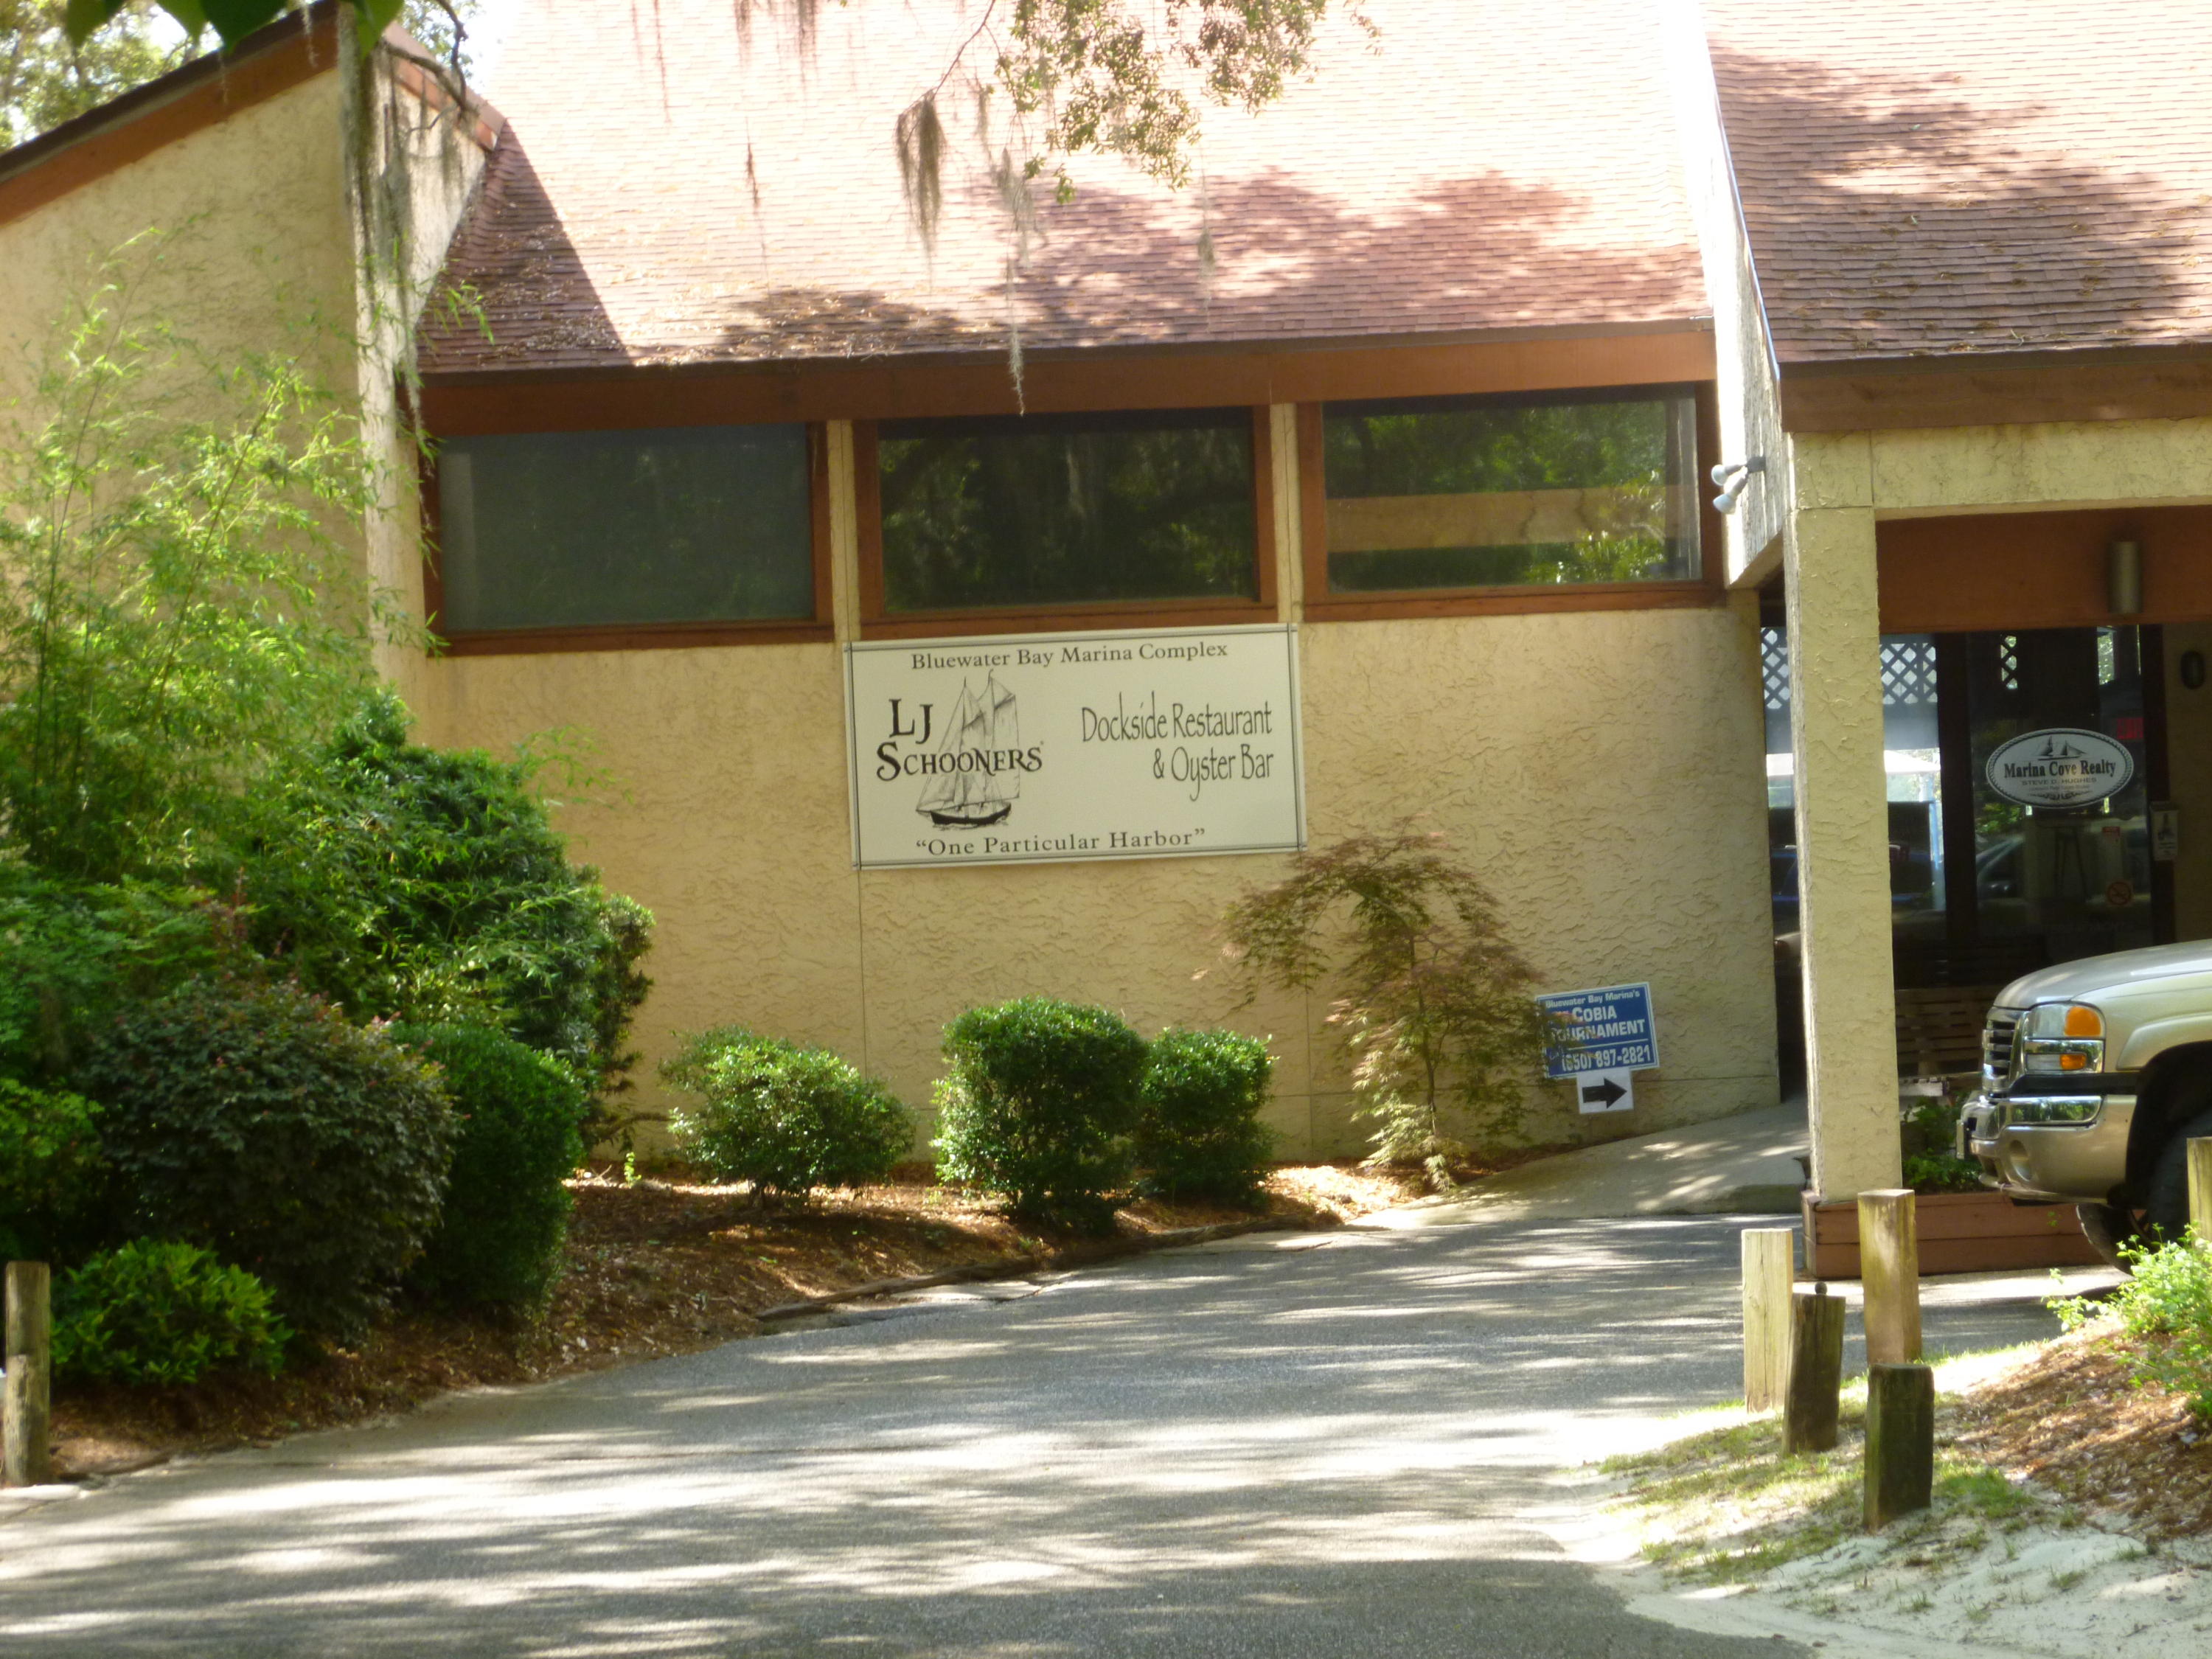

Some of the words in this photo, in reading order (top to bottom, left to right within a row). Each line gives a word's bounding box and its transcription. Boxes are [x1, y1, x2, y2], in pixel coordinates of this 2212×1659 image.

[911, 652, 1012, 669] Bluewater
[1016, 649, 1054, 668] Bay
[1060, 644, 1133, 664] Marina
[1138, 642, 1228, 664] Complex
[888, 698, 933, 745] LJ
[1081, 690, 1168, 742] Dockside
[1172, 700, 1273, 738] Restaurant
[876, 740, 1043, 782] SCHOONERS
[1152, 748, 1165, 779] &
[1170, 745, 1236, 801] Oyster
[1240, 743, 1274, 779] Bar
[2004, 762, 2045, 779] Marina
[2049, 761, 2077, 776] Cove
[2080, 759, 2116, 778] Realty
[983, 833, 1101, 854] Particular
[1545, 998, 1586, 1009] Bluewater
[1587, 995, 1604, 1004] Bay
[1605, 990, 1641, 1001] Marina's
[1572, 1004, 1618, 1023] COBIA
[1595, 1044, 1652, 1068] 897-2821
